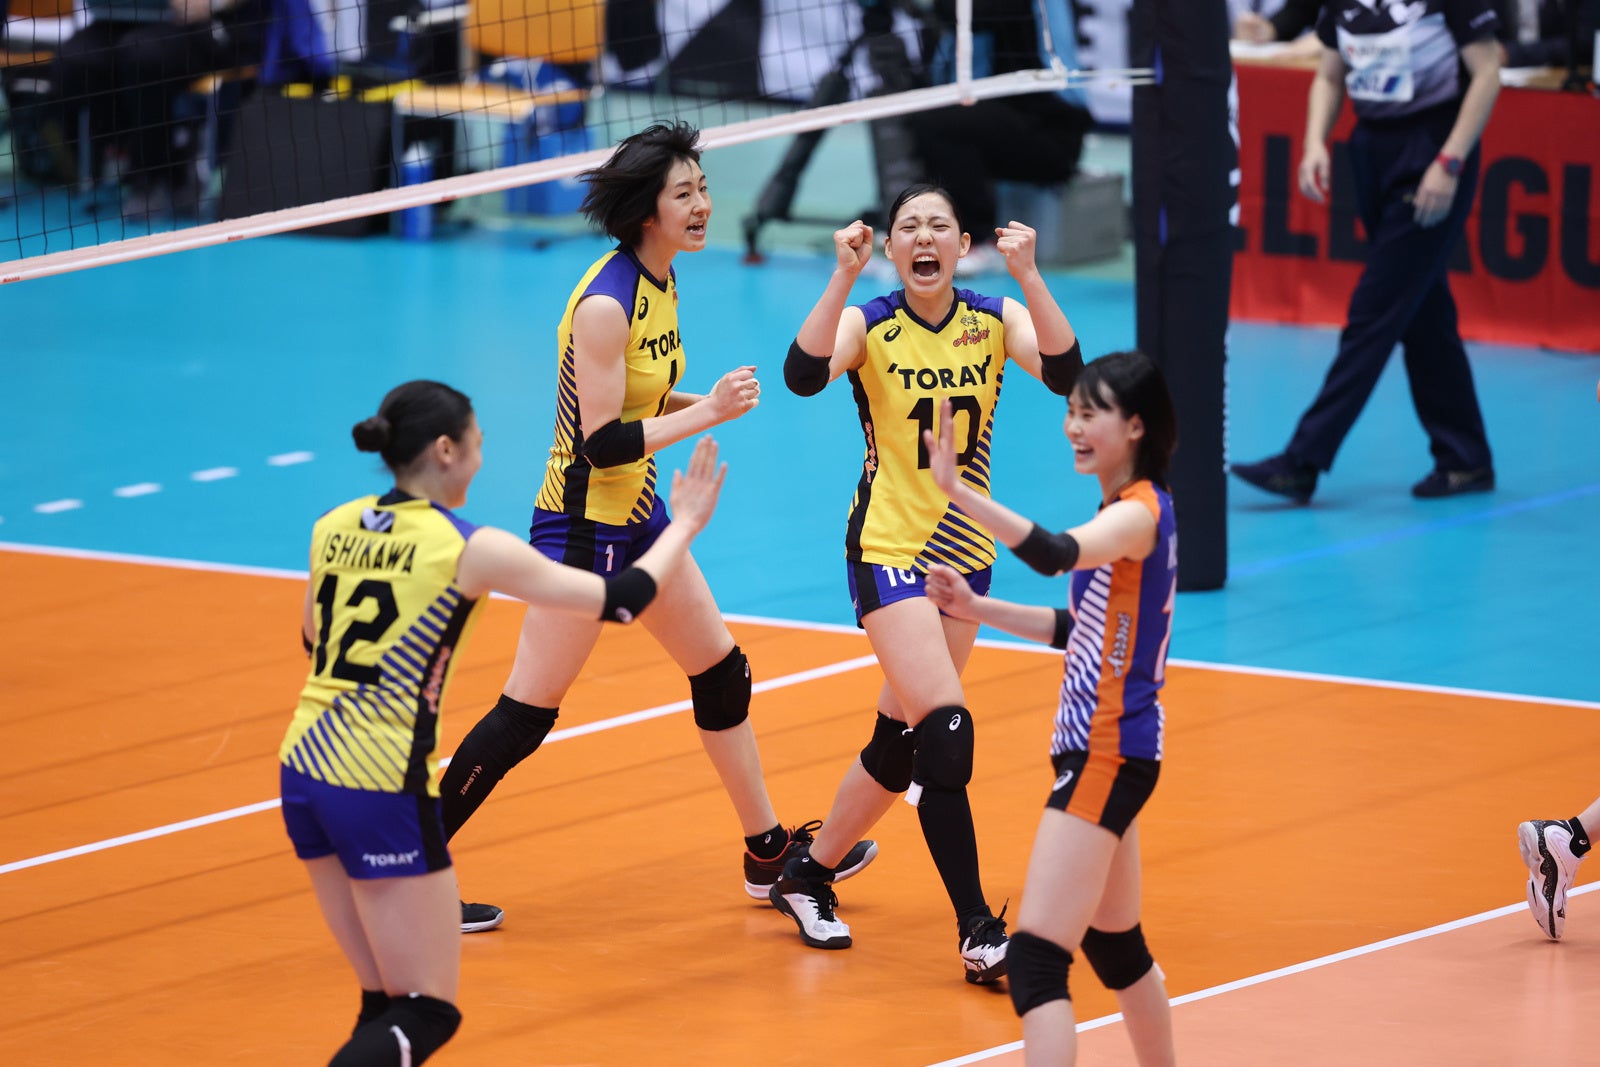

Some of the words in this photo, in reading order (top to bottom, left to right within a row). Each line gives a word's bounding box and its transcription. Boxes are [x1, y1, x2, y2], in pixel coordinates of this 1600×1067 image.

[320, 531, 417, 575] ISHIKAWA
[605, 543, 615, 572] 1
[315, 573, 400, 686] 12
